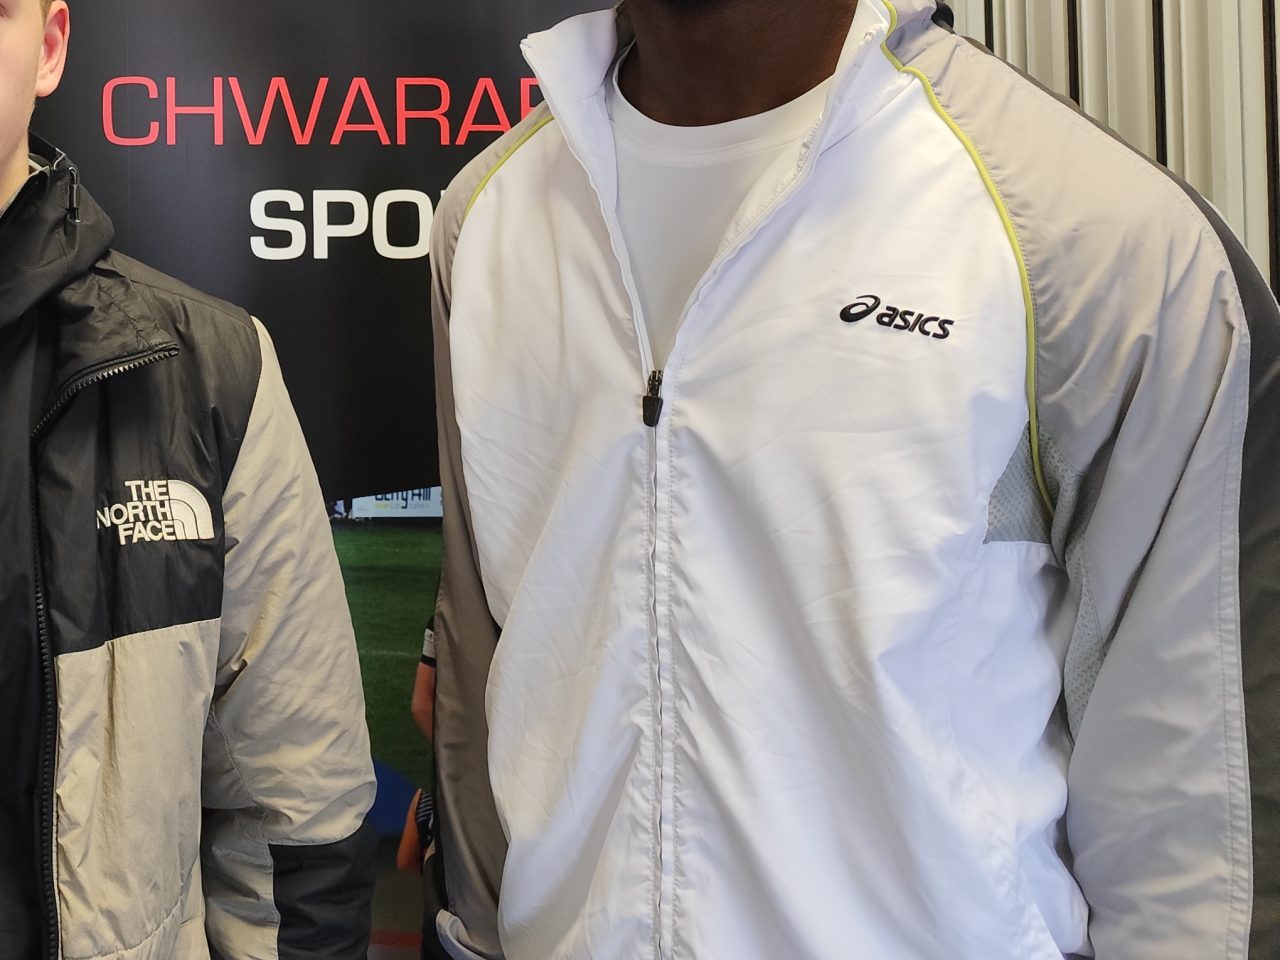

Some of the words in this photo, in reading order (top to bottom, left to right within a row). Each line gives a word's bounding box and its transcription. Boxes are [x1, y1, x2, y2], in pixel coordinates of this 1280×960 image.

[249, 188, 441, 261] SPO
[876, 305, 955, 340] asics
[124, 480, 170, 501] THE
[96, 500, 173, 529] NORTH
[118, 520, 177, 546] FACE
